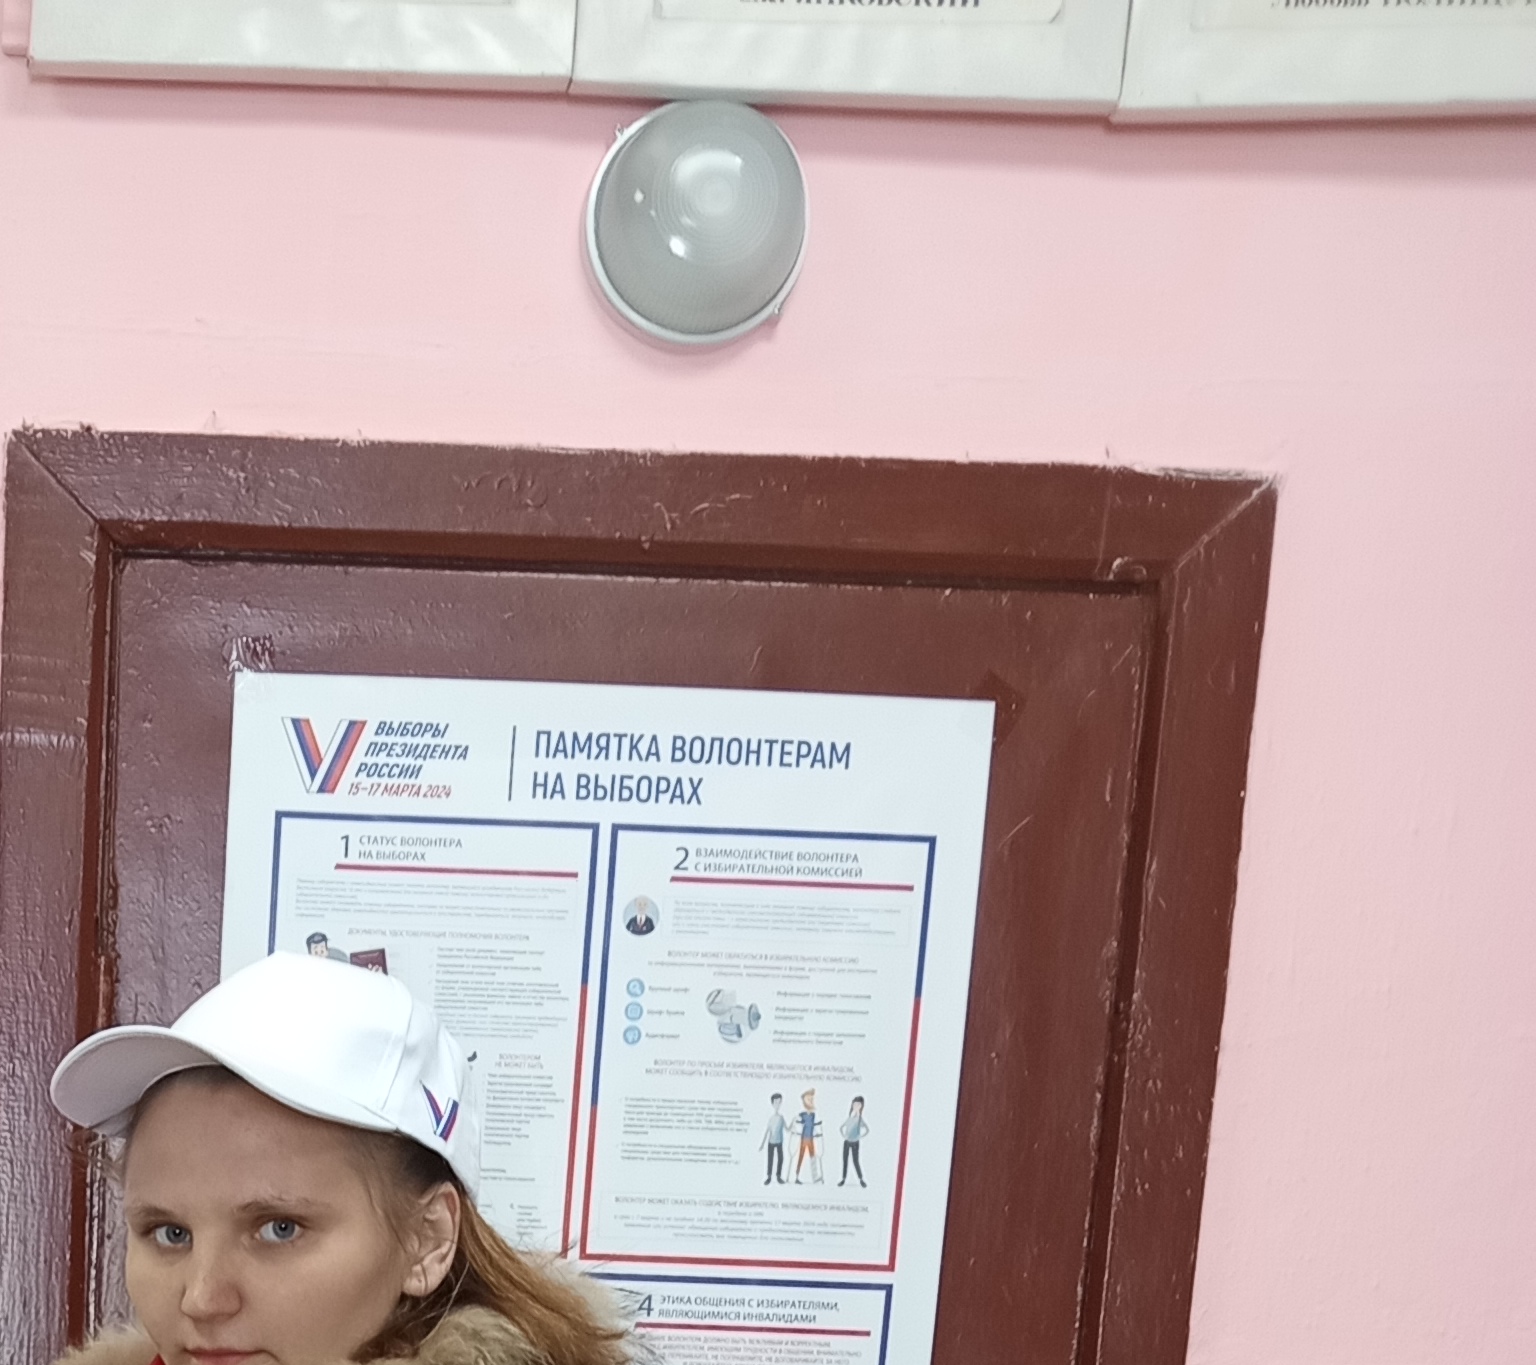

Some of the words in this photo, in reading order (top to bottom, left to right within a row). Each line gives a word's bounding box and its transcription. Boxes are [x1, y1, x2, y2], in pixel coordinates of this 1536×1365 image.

[374, 720, 449, 739] ВЫБОРЫ
[364, 741, 469, 761] ПРЕЗИДЕНТА
[534, 730, 661, 762] ПАМЯТКА
[670, 735, 851, 770] ВОЛОНТЕРАМ
[354, 762, 423, 780] РОССИИ
[347, 782, 378, 797] 15–17
[380, 784, 422, 799] МАРТА
[423, 786, 452, 799] 2024
[531, 773, 566, 800] НА
[575, 774, 703, 805] ВЫБОРАХ
[340, 835, 350, 859] 1
[358, 834, 397, 846] СТАТУС
[399, 836, 463, 848] ВОЛОНТЕРА
[358, 849, 374, 860] НА
[375, 849, 426, 861] ВЫБОРАХ
[674, 846, 689, 871] 2
[695, 847, 793, 861] ВЗАИМОДЕЙСТВИЕ
[796, 851, 859, 863] ВОЛОНТЕРА
[694, 863, 700, 872] С
[703, 863, 794, 875] ИЗБИРАТЕЛЬНОЙ
[796, 866, 862, 877] КОМИССИЕЙ
[638, 1294, 654, 1317] 4
[660, 1295, 692, 1305] ЭТИКА
[694, 1296, 745, 1307] ОБЩЕНИЯ
[747, 1298, 754, 1308] С
[657, 1309, 740, 1320] ЯВЛЯЮЩИМИСЯ
[742, 1312, 816, 1323] ИНВАЛИДАМИ
